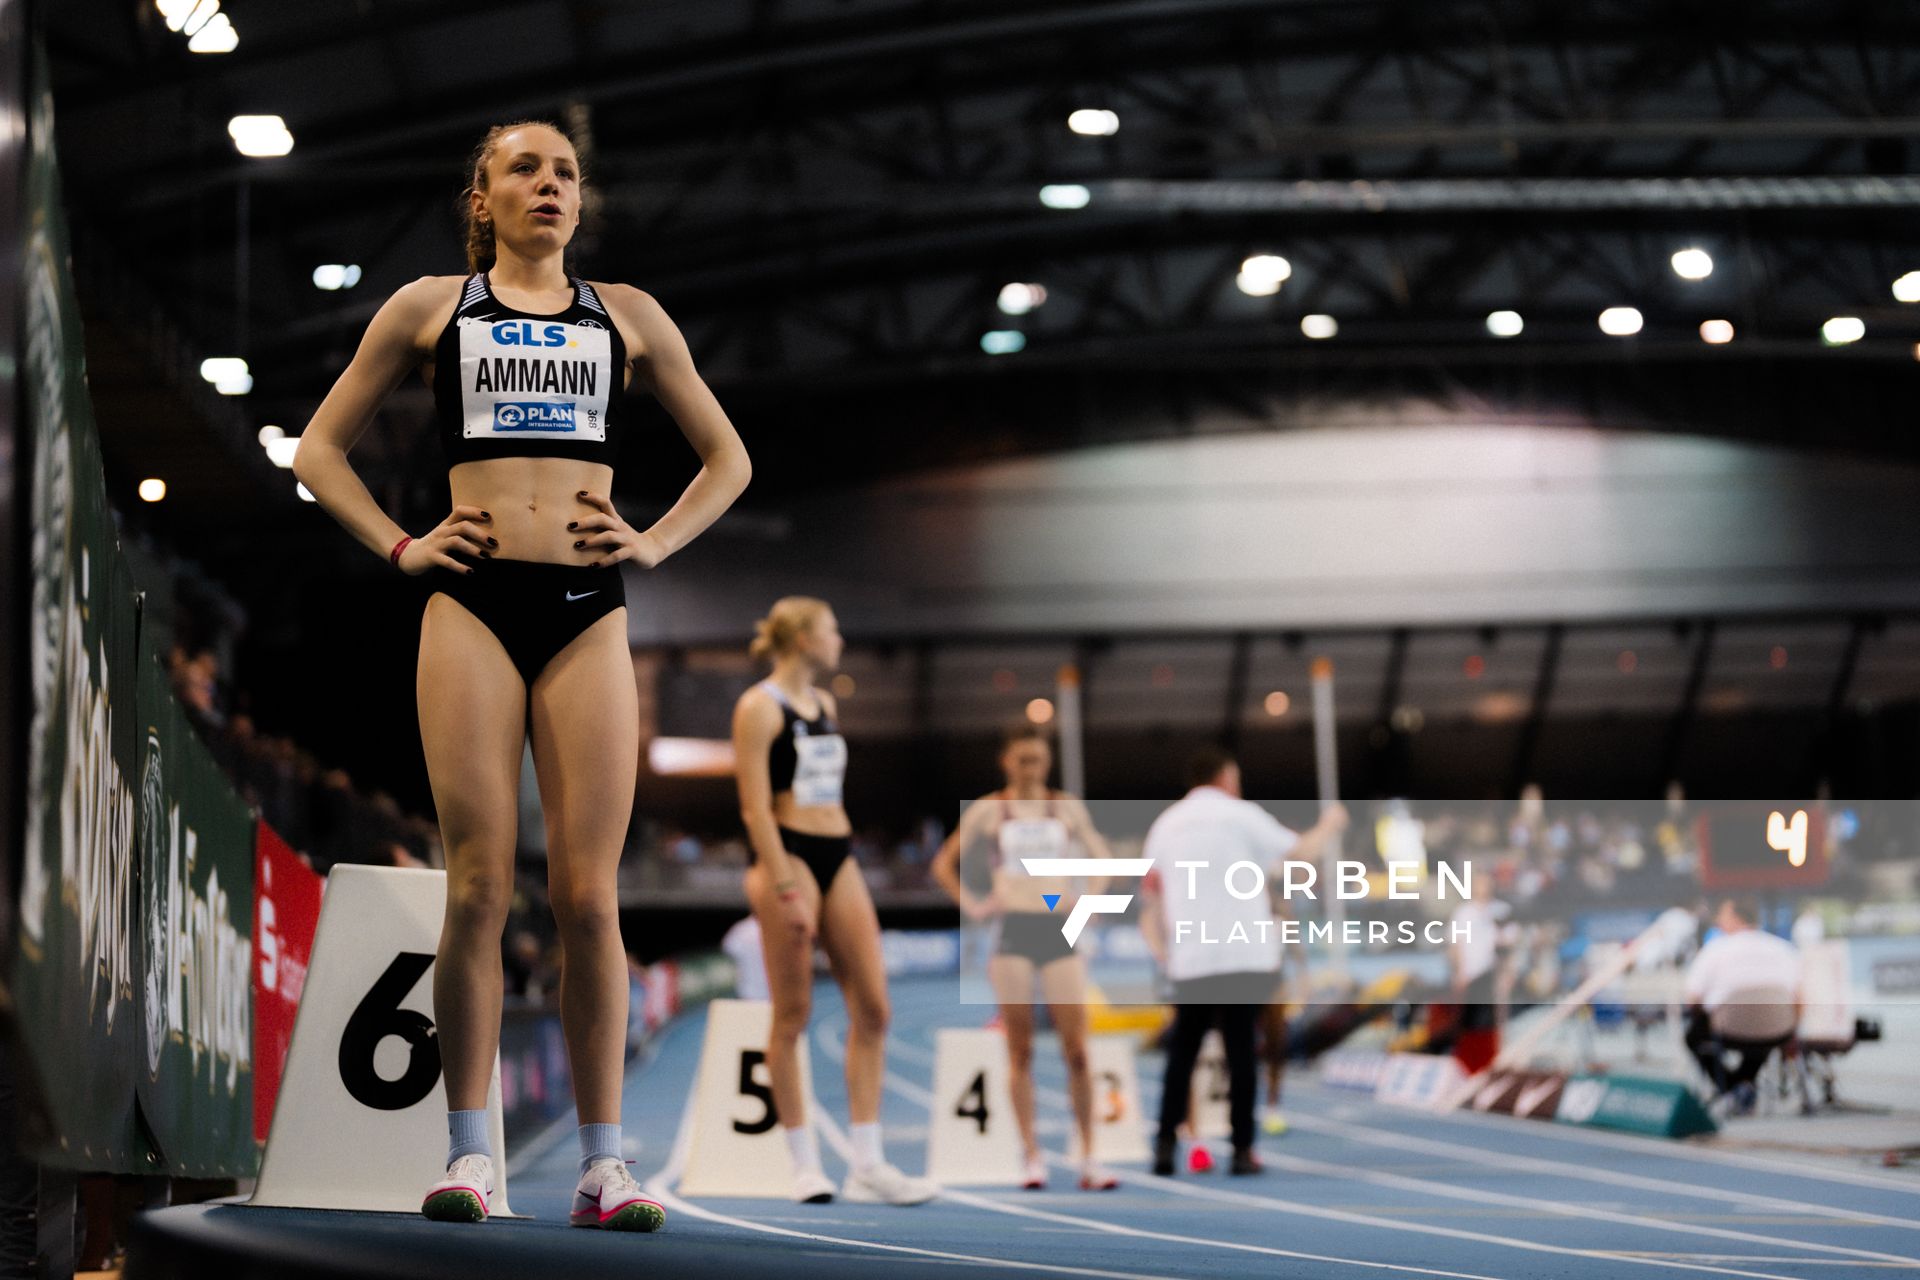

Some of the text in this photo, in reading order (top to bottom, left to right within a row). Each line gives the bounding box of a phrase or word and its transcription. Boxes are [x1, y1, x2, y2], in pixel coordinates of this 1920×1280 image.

[475, 357, 597, 396] AMMANN
[528, 407, 573, 421] PLAN
[586, 409, 598, 429] 368
[1765, 809, 1808, 867] 4
[338, 952, 442, 1110] 6
[732, 1050, 777, 1134] 5
[954, 1071, 989, 1133] 4
